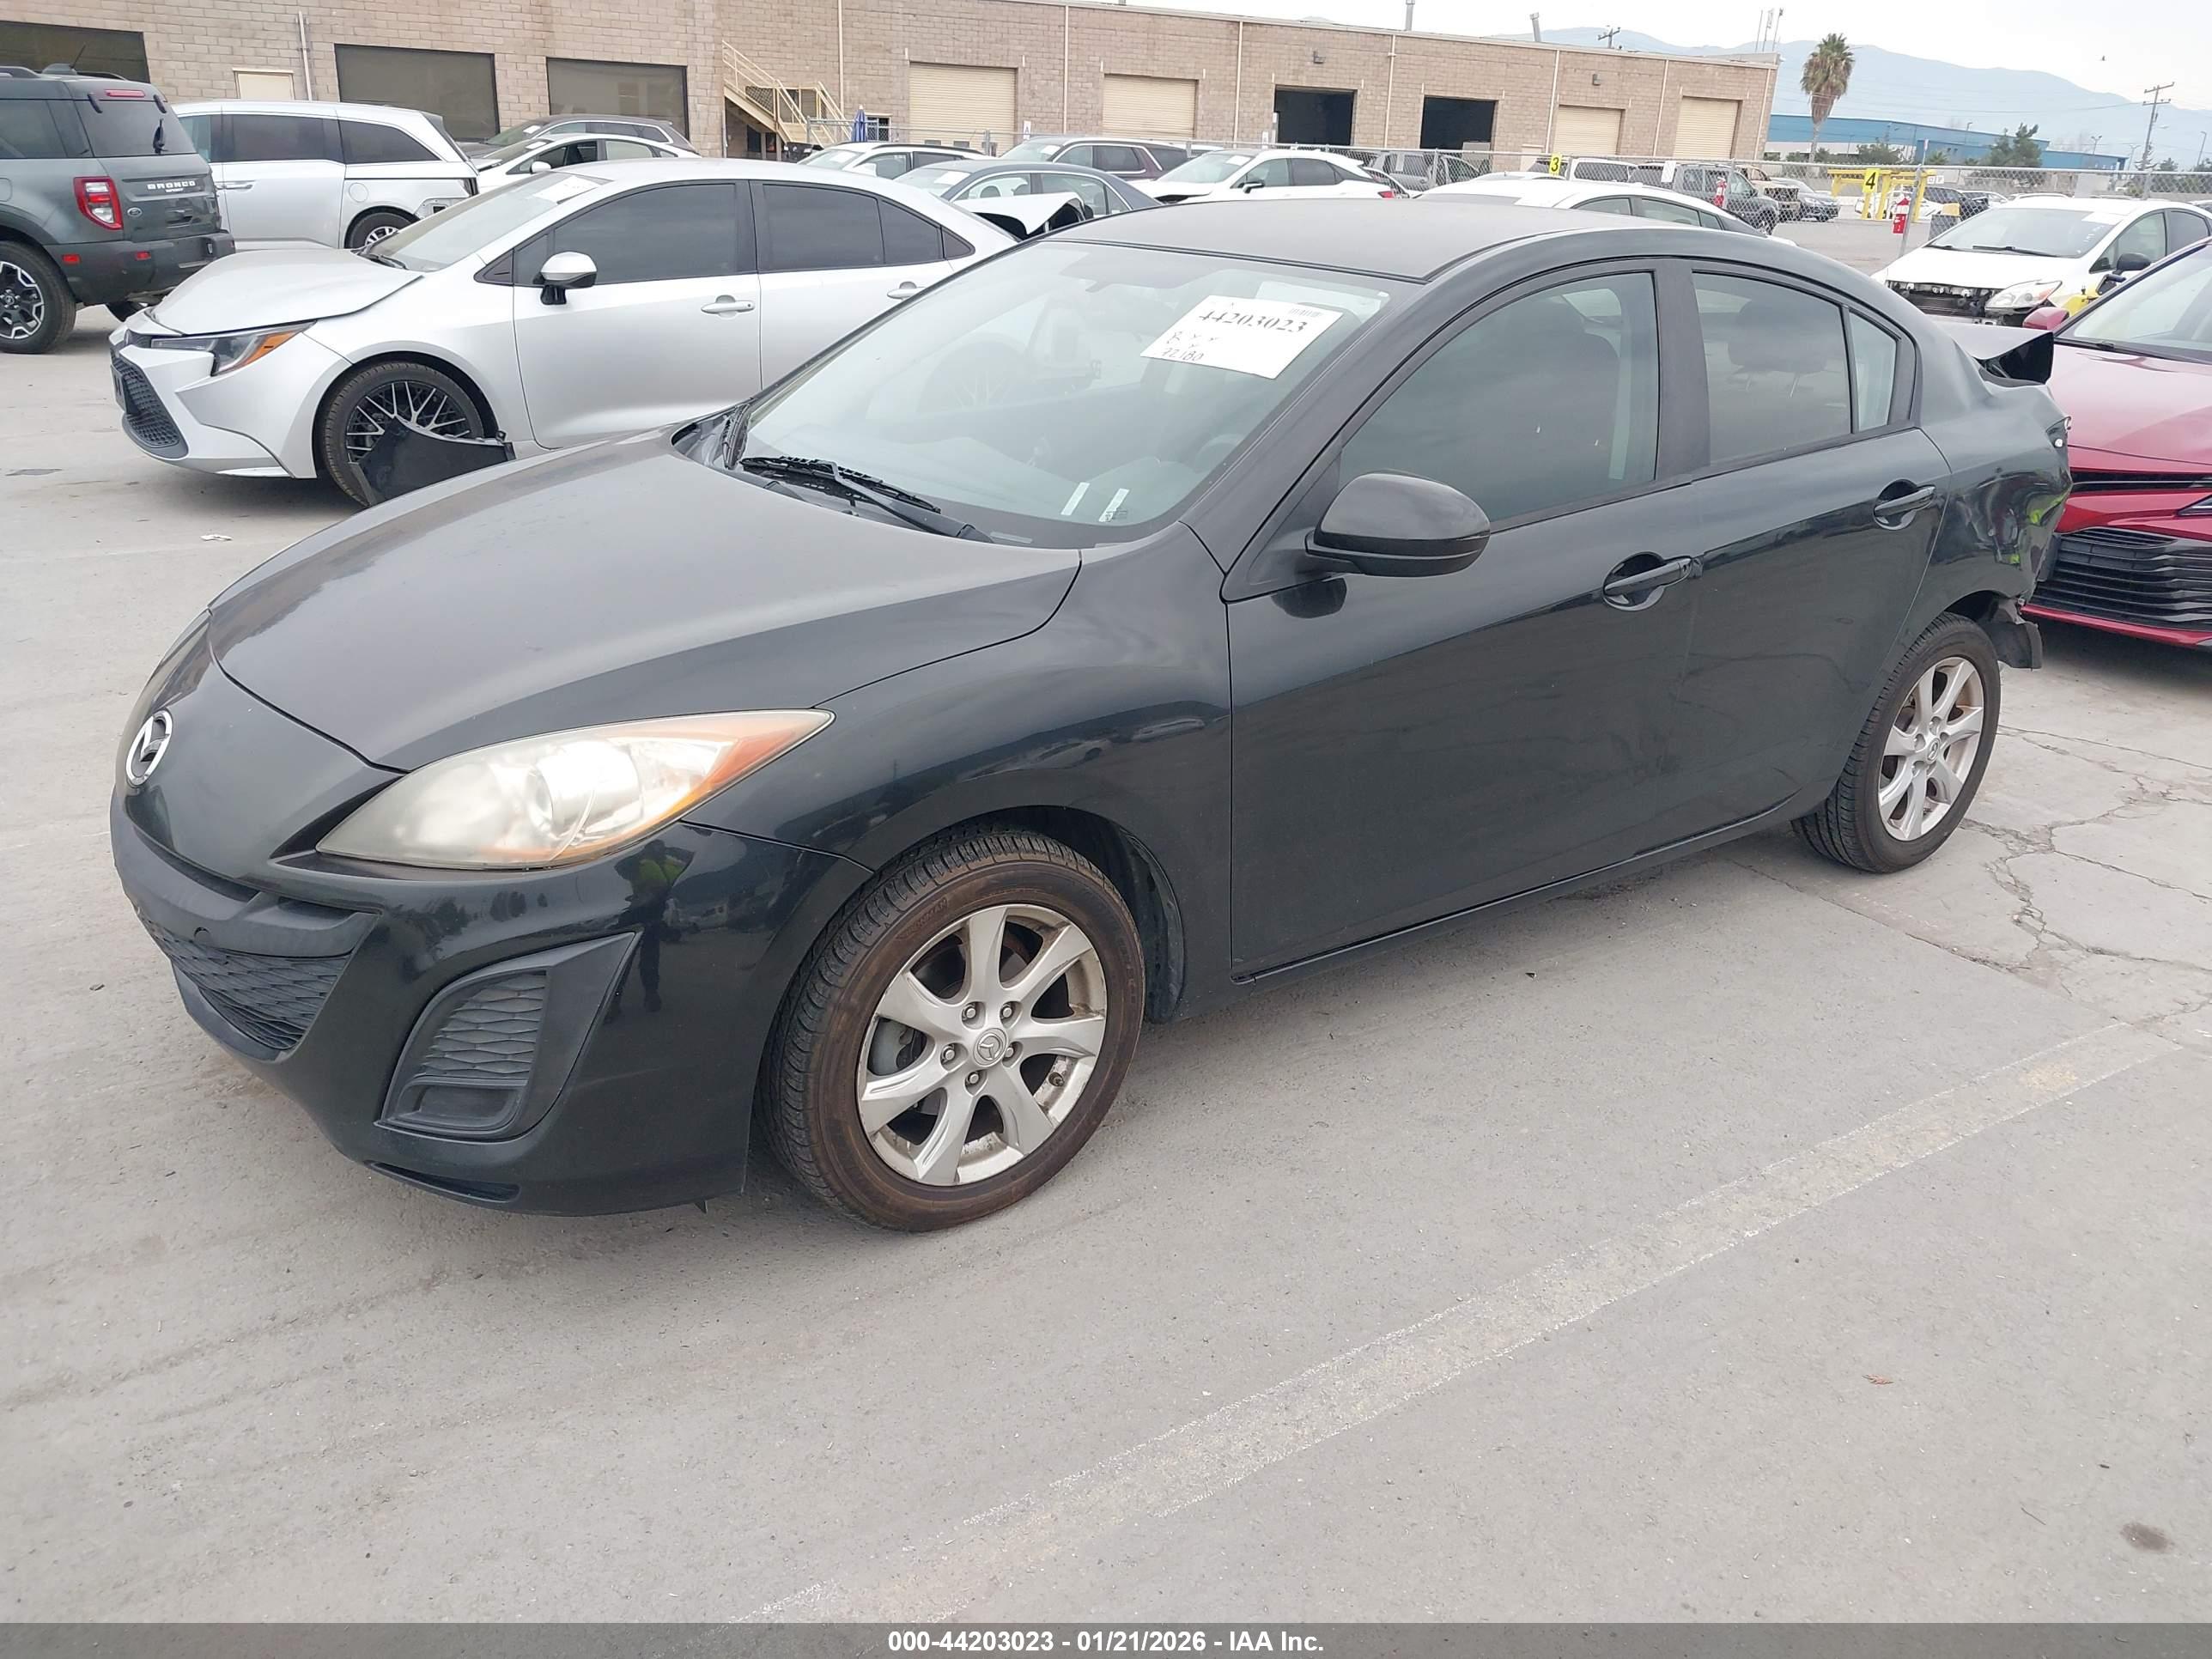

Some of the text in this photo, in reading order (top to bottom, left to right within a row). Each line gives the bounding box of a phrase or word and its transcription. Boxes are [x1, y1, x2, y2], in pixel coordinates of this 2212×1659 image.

[1551, 157, 1559, 172] 3
[1865, 172, 1876, 190] 4
[1199, 310, 1308, 332] 44203023
